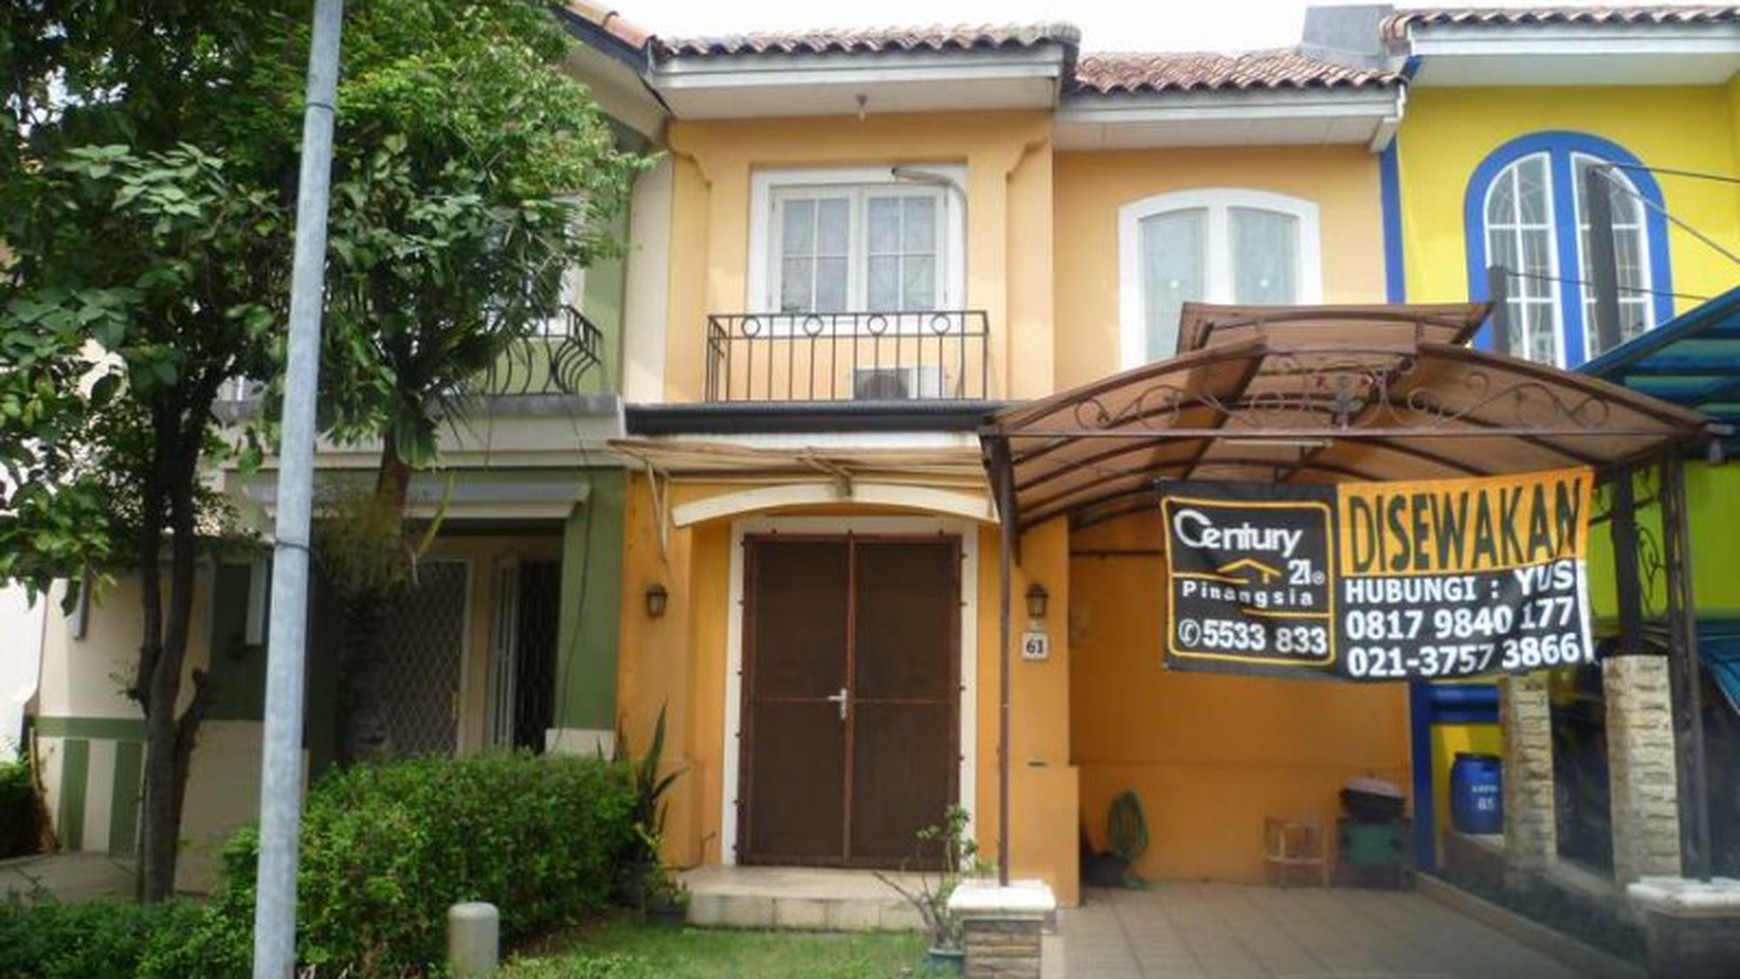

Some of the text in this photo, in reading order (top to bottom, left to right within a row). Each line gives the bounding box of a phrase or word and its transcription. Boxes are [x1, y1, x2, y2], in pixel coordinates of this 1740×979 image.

[1173, 508, 1303, 558] Century
[1347, 478, 1581, 573] DISEWAKAN
[1182, 580, 1314, 608] Pinangsia
[1345, 576, 1477, 604] HUBUNGI
[1513, 559, 1575, 596] YUS
[1202, 618, 1328, 655] 5533 833
[1346, 596, 1575, 640] 0817 9840 177
[1026, 638, 1044, 655] 61
[1347, 631, 1580, 677] 021-3757 3866
